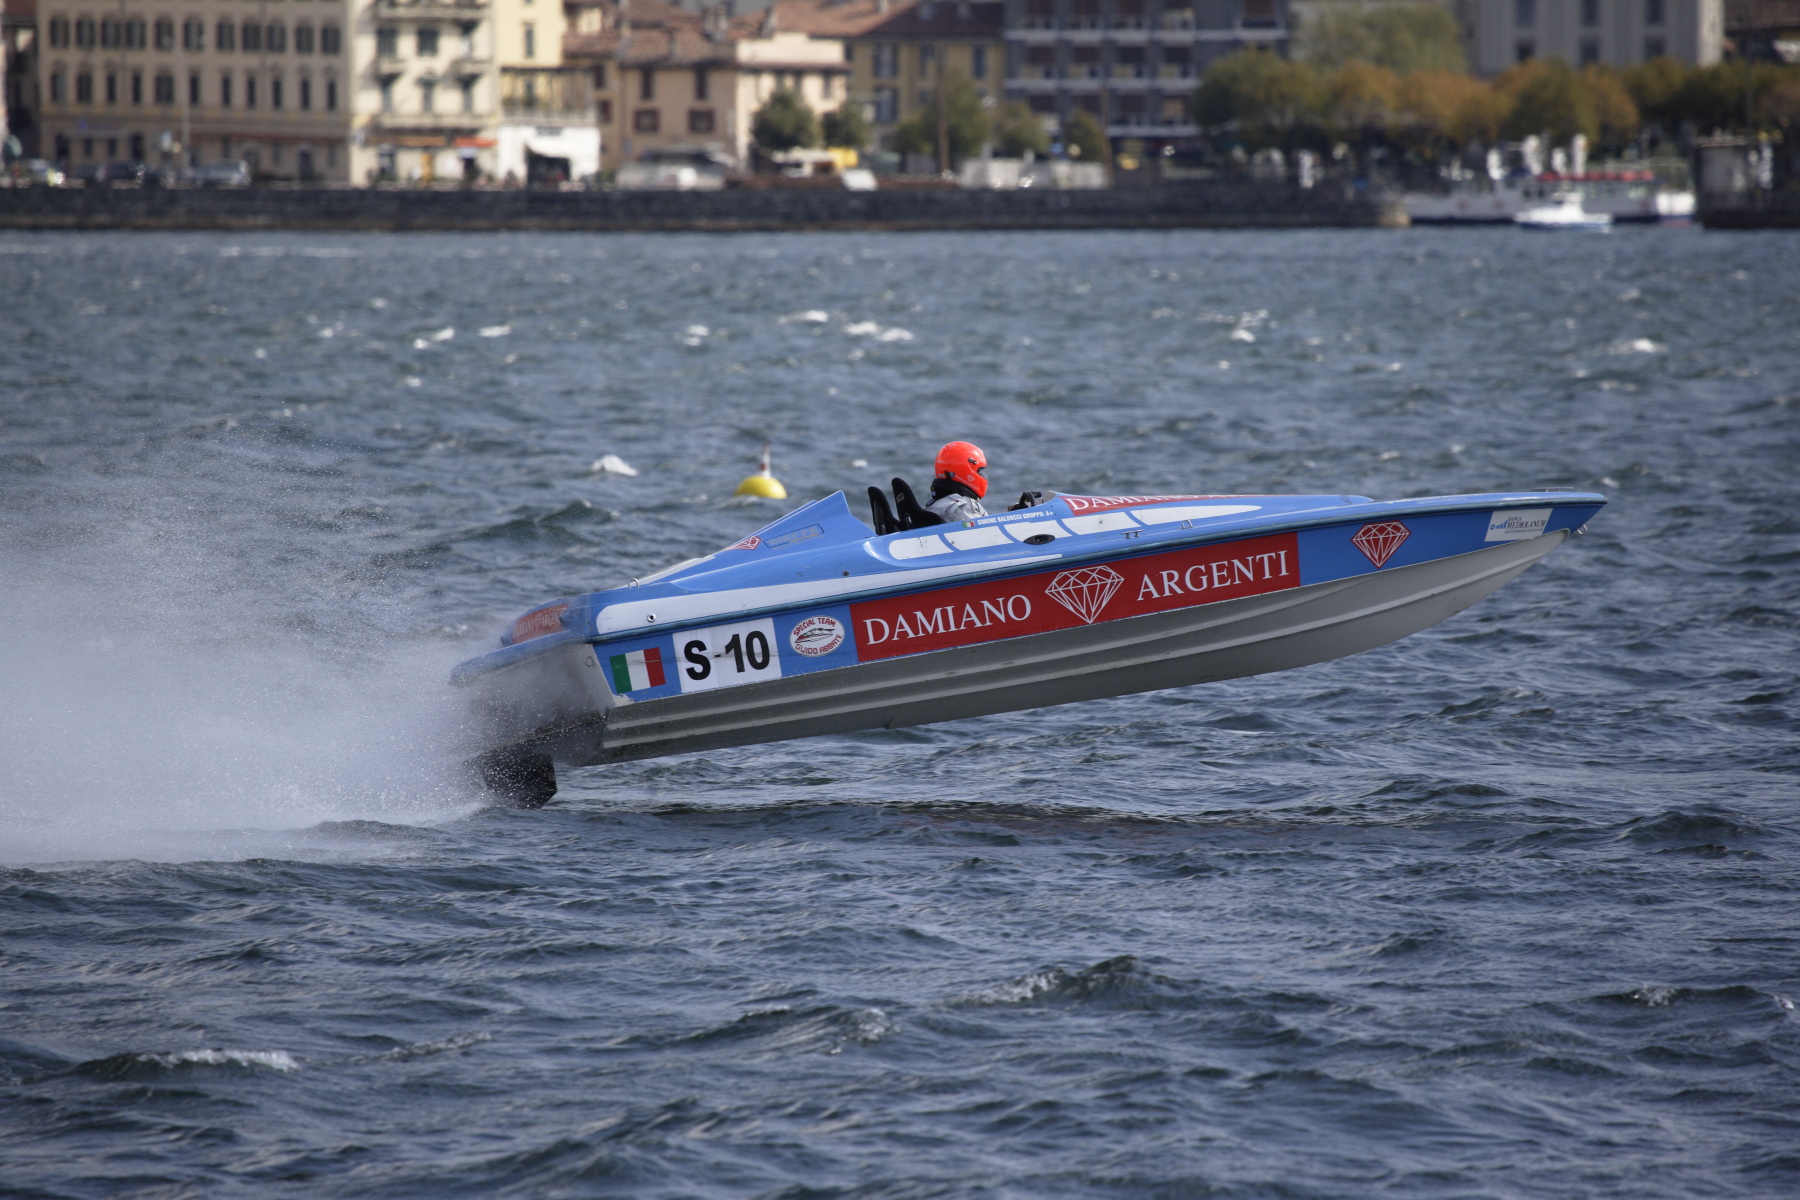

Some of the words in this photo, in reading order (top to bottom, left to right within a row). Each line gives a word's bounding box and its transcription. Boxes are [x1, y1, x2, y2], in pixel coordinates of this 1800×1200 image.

[997, 514, 1022, 523] BALDUCCI
[1506, 519, 1547, 529] MEDIOLANUM
[863, 594, 1032, 646] DAMIANO
[1137, 550, 1290, 602] ARGENTI
[793, 619, 816, 636] SPECIAL
[817, 618, 836, 627] TEAM
[795, 643, 818, 655] GUIDO
[820, 633, 843, 654] ABBATE
